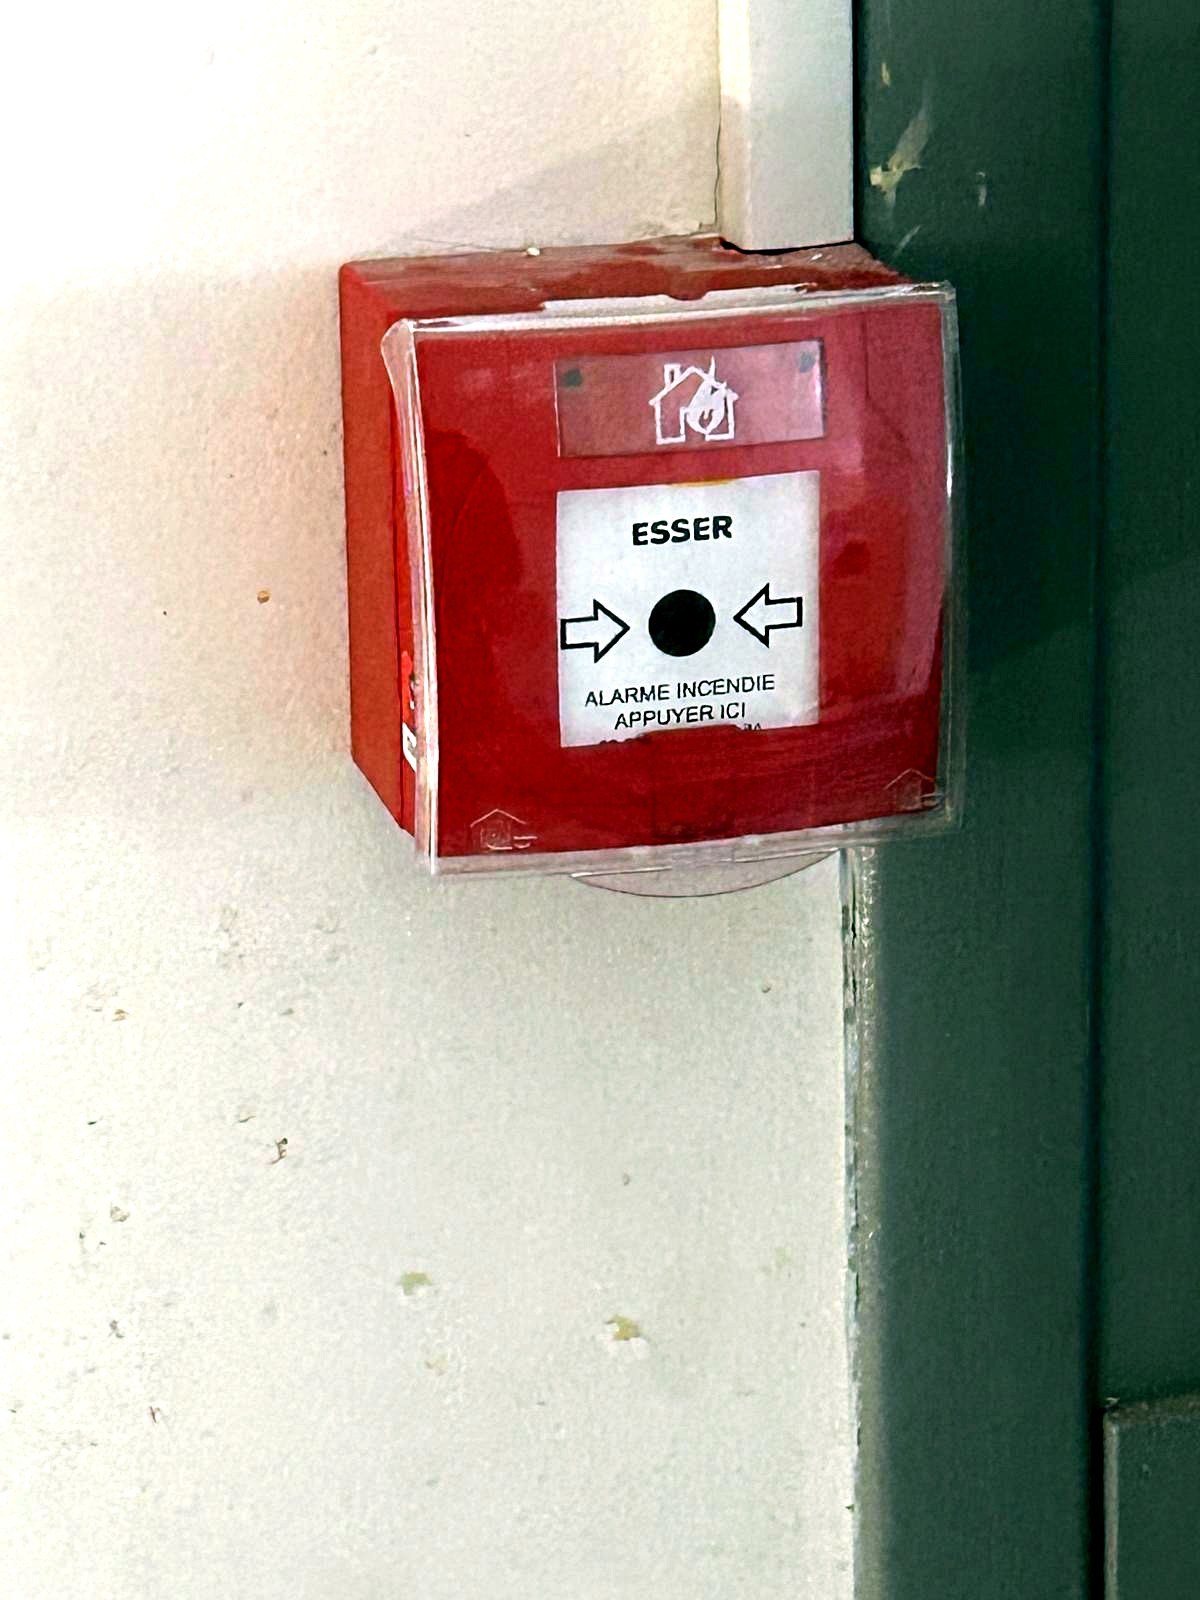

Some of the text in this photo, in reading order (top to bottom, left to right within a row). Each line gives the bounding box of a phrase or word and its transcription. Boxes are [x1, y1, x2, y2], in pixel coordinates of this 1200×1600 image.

[632, 515, 733, 546] ESSER
[584, 674, 776, 707] ALARME INCENDIE
[614, 702, 746, 730] APPUYER ICI
